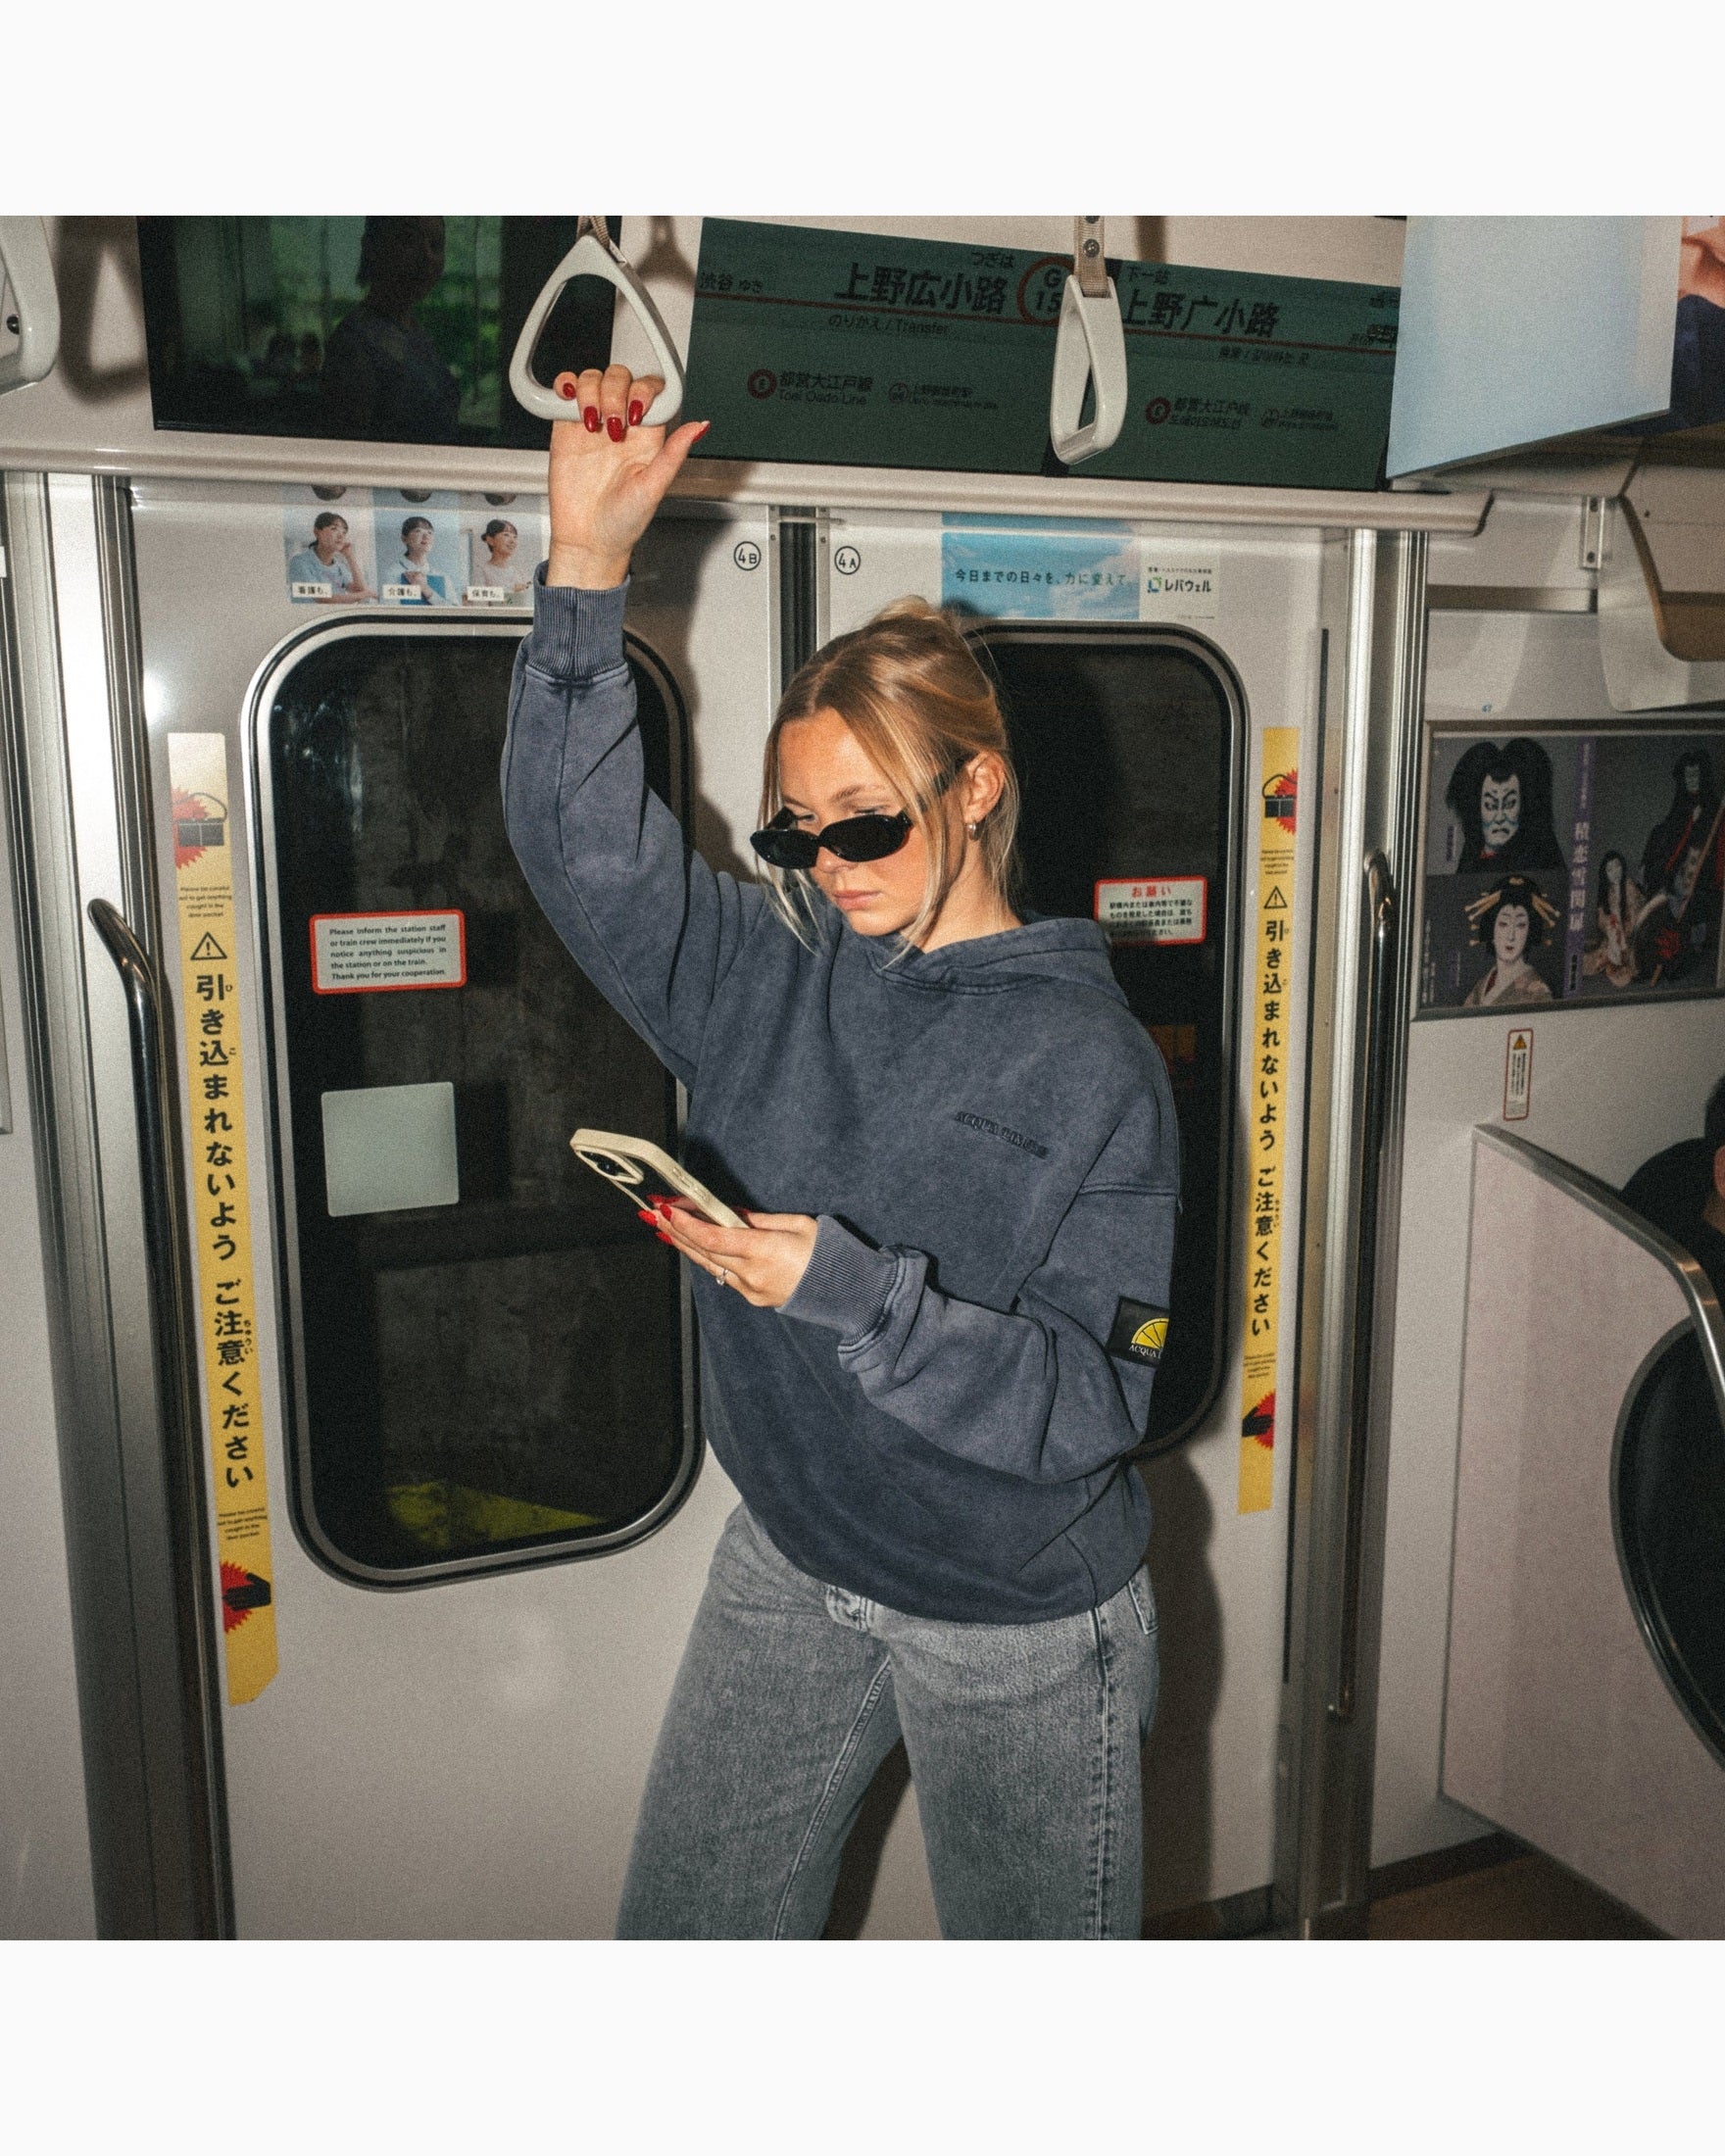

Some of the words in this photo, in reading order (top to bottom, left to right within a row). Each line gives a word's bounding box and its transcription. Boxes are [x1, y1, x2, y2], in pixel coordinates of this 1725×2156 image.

[971, 250, 1015, 269] つぎは
[700, 272, 733, 291] 渋谷
[1044, 268, 1061, 287] G
[833, 262, 1009, 315] 上野広小路
[1035, 291, 1061, 313] 15
[1122, 288, 1280, 338] 上野广小路
[896, 318, 950, 334] Transfer
[738, 548, 757, 564] 4B
[838, 553, 857, 568] 4A
[1164, 579, 1212, 593] レバウェル
[1132, 886, 1171, 899] お願い
[378, 936, 424, 946] immediately
[359, 950, 393, 958] anything
[397, 948, 435, 956] suspicious
[332, 972, 355, 981] Thank
[371, 970, 382, 979] for
[1258, 919, 1284, 1152] 引き込まれないよう
[196, 973, 236, 1261] 引き込まれないよう
[1251, 1166, 1276, 1336] ご注意ください
[1128, 1345, 1157, 1358] ACQUA
[213, 1277, 255, 1489] ご注意ください
